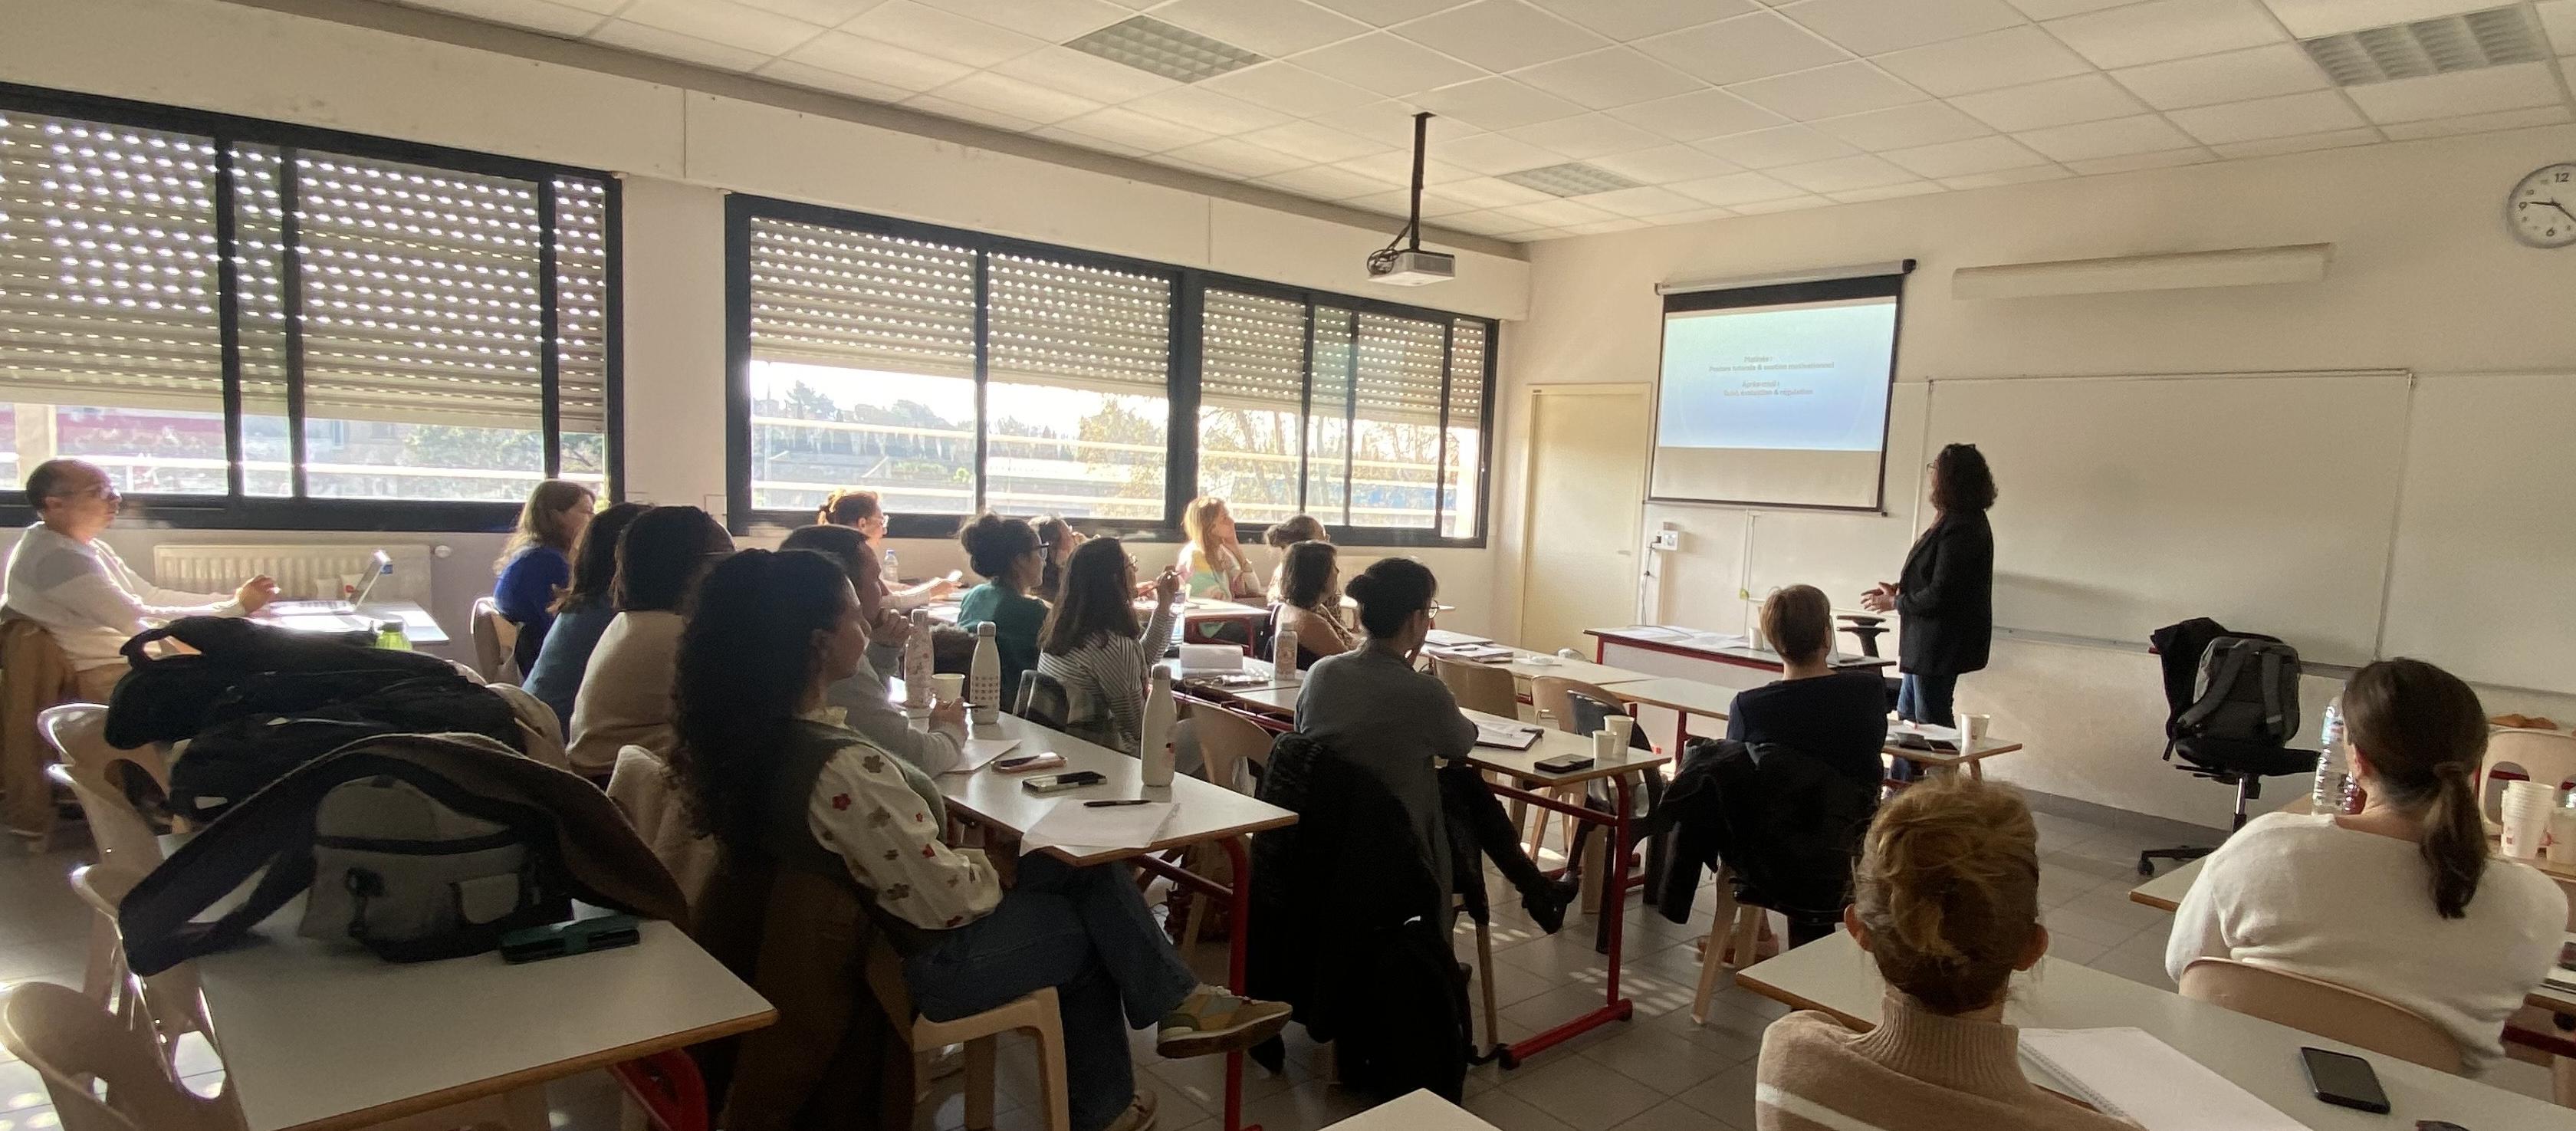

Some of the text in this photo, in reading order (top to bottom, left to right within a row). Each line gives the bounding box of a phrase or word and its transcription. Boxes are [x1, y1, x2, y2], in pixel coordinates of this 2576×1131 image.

[2555, 172, 2570, 182] 12
[2518, 201, 2528, 212] 9
[2546, 227, 2555, 237] 6
